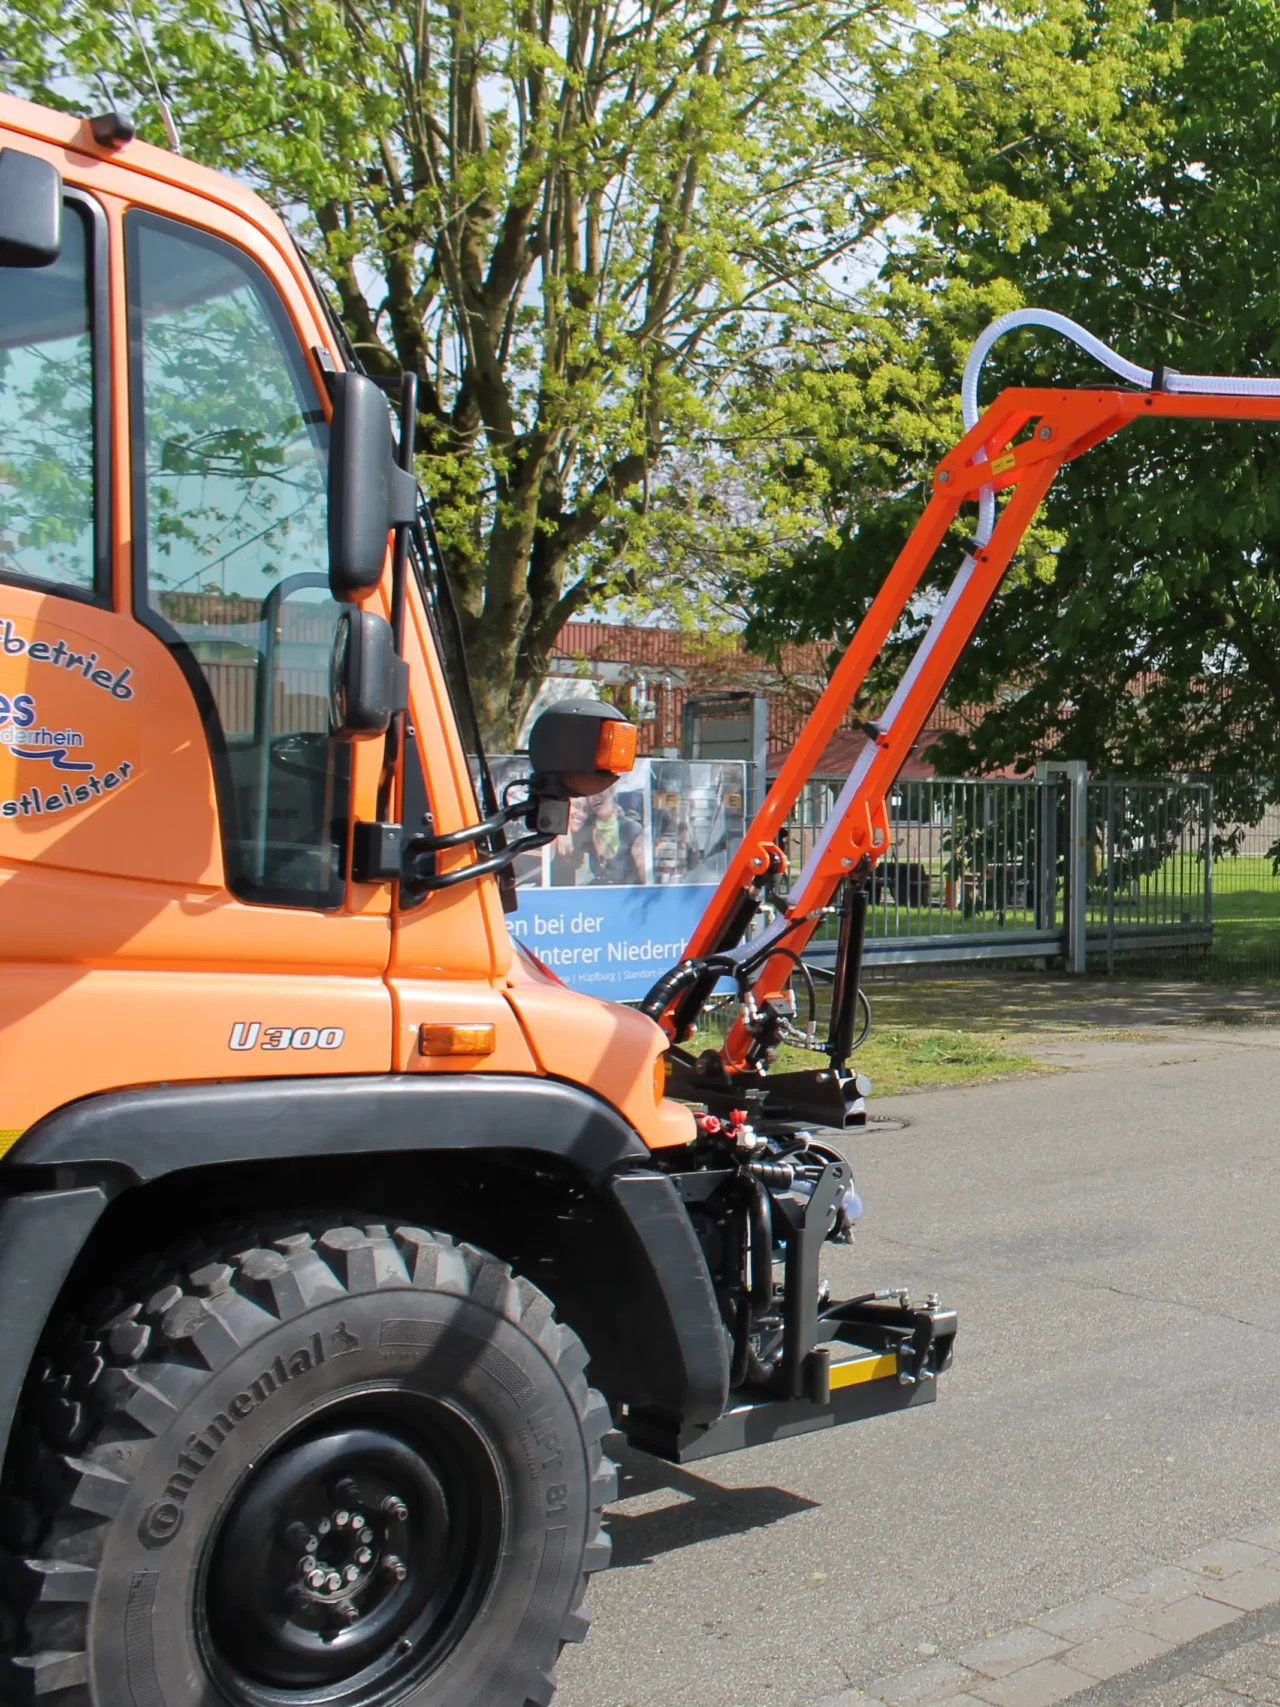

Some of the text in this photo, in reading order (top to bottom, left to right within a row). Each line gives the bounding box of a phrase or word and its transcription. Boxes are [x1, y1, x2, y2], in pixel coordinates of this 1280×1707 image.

[0, 618, 134, 700] betrieb
[1, 727, 83, 747] derrhein
[1, 761, 132, 817] stleister
[534, 913, 565, 935] bei
[570, 912, 604, 934] der
[137, 1331, 325, 1550] Continental
